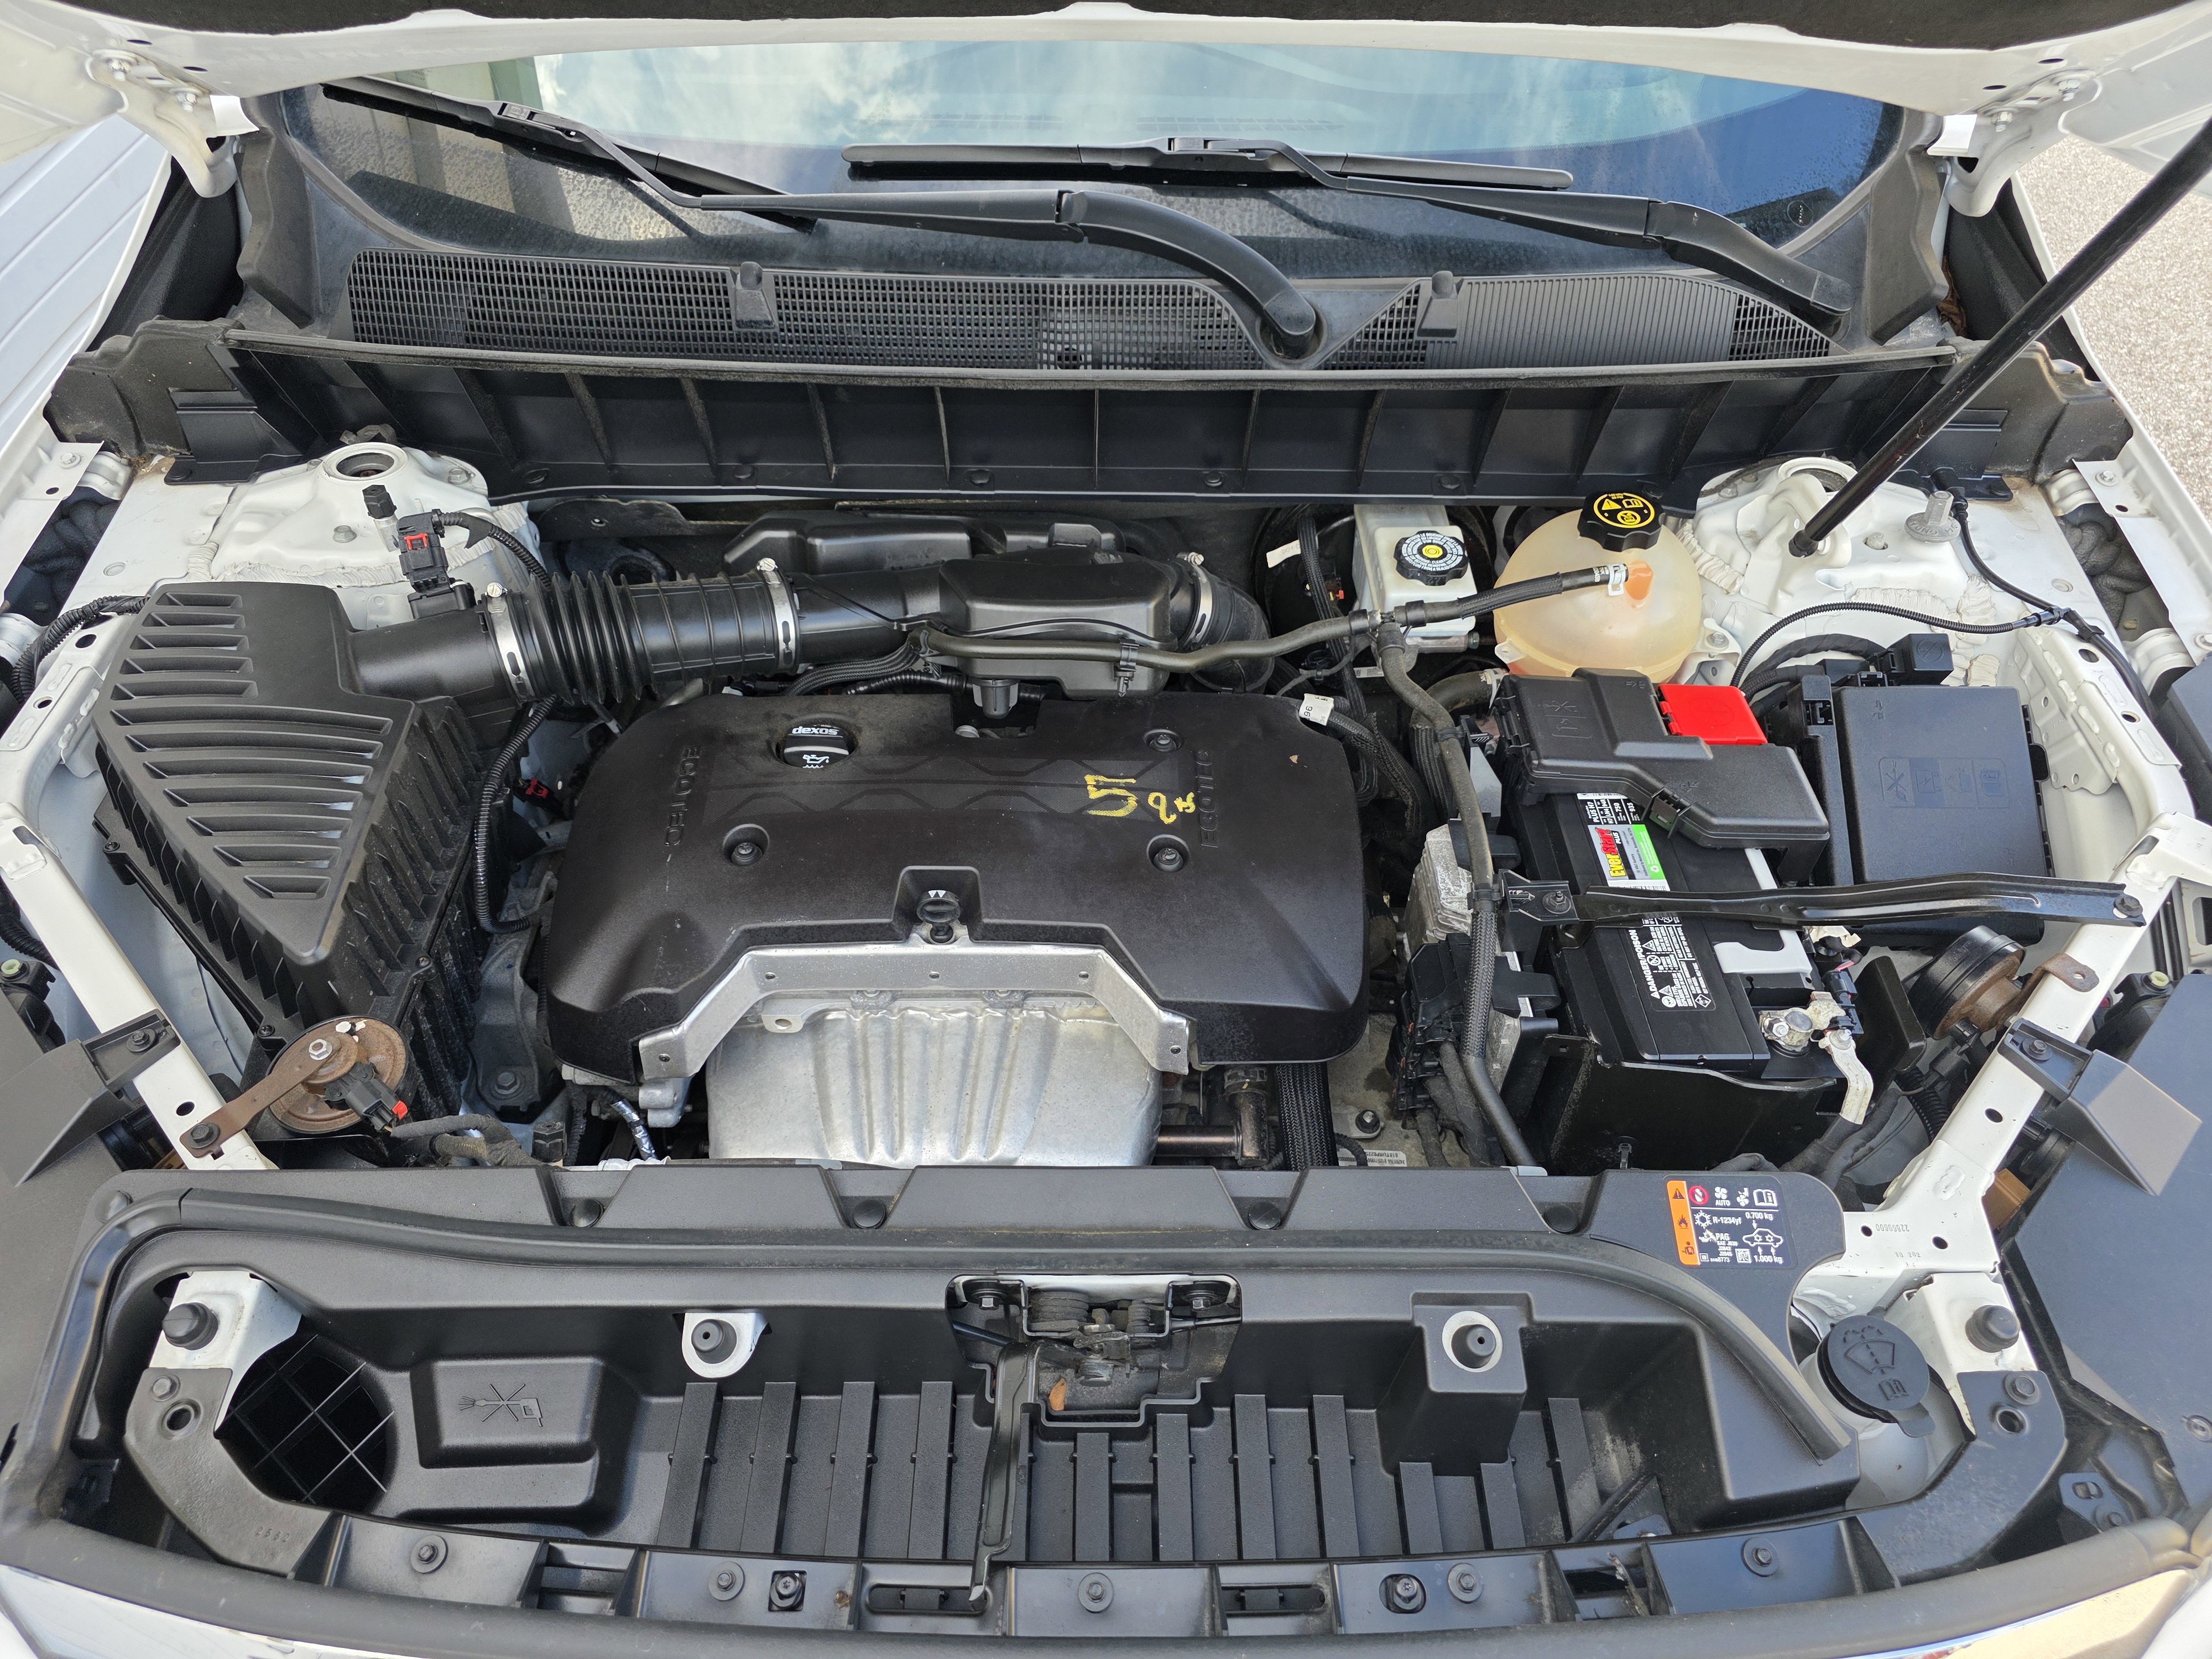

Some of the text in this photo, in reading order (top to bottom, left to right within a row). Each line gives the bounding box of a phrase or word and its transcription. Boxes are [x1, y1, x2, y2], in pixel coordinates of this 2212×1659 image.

[792, 726, 839, 735] dexos
[664, 745, 702, 847] ECOTEC
[1194, 749, 1219, 848] ECOTEC
[1613, 802, 1622, 812] 750
[1626, 802, 1636, 811] 935
[1589, 809, 1600, 822] PLUS
[1612, 832, 1622, 844] PLUS
[1595, 828, 1626, 877] EverStart
[1628, 929, 1657, 992] DANGER/POISON
[1712, 1217, 1742, 1225] R-1234yf
[1764, 1213, 1774, 1221] kg
[1773, 1255, 1784, 1264] kg
